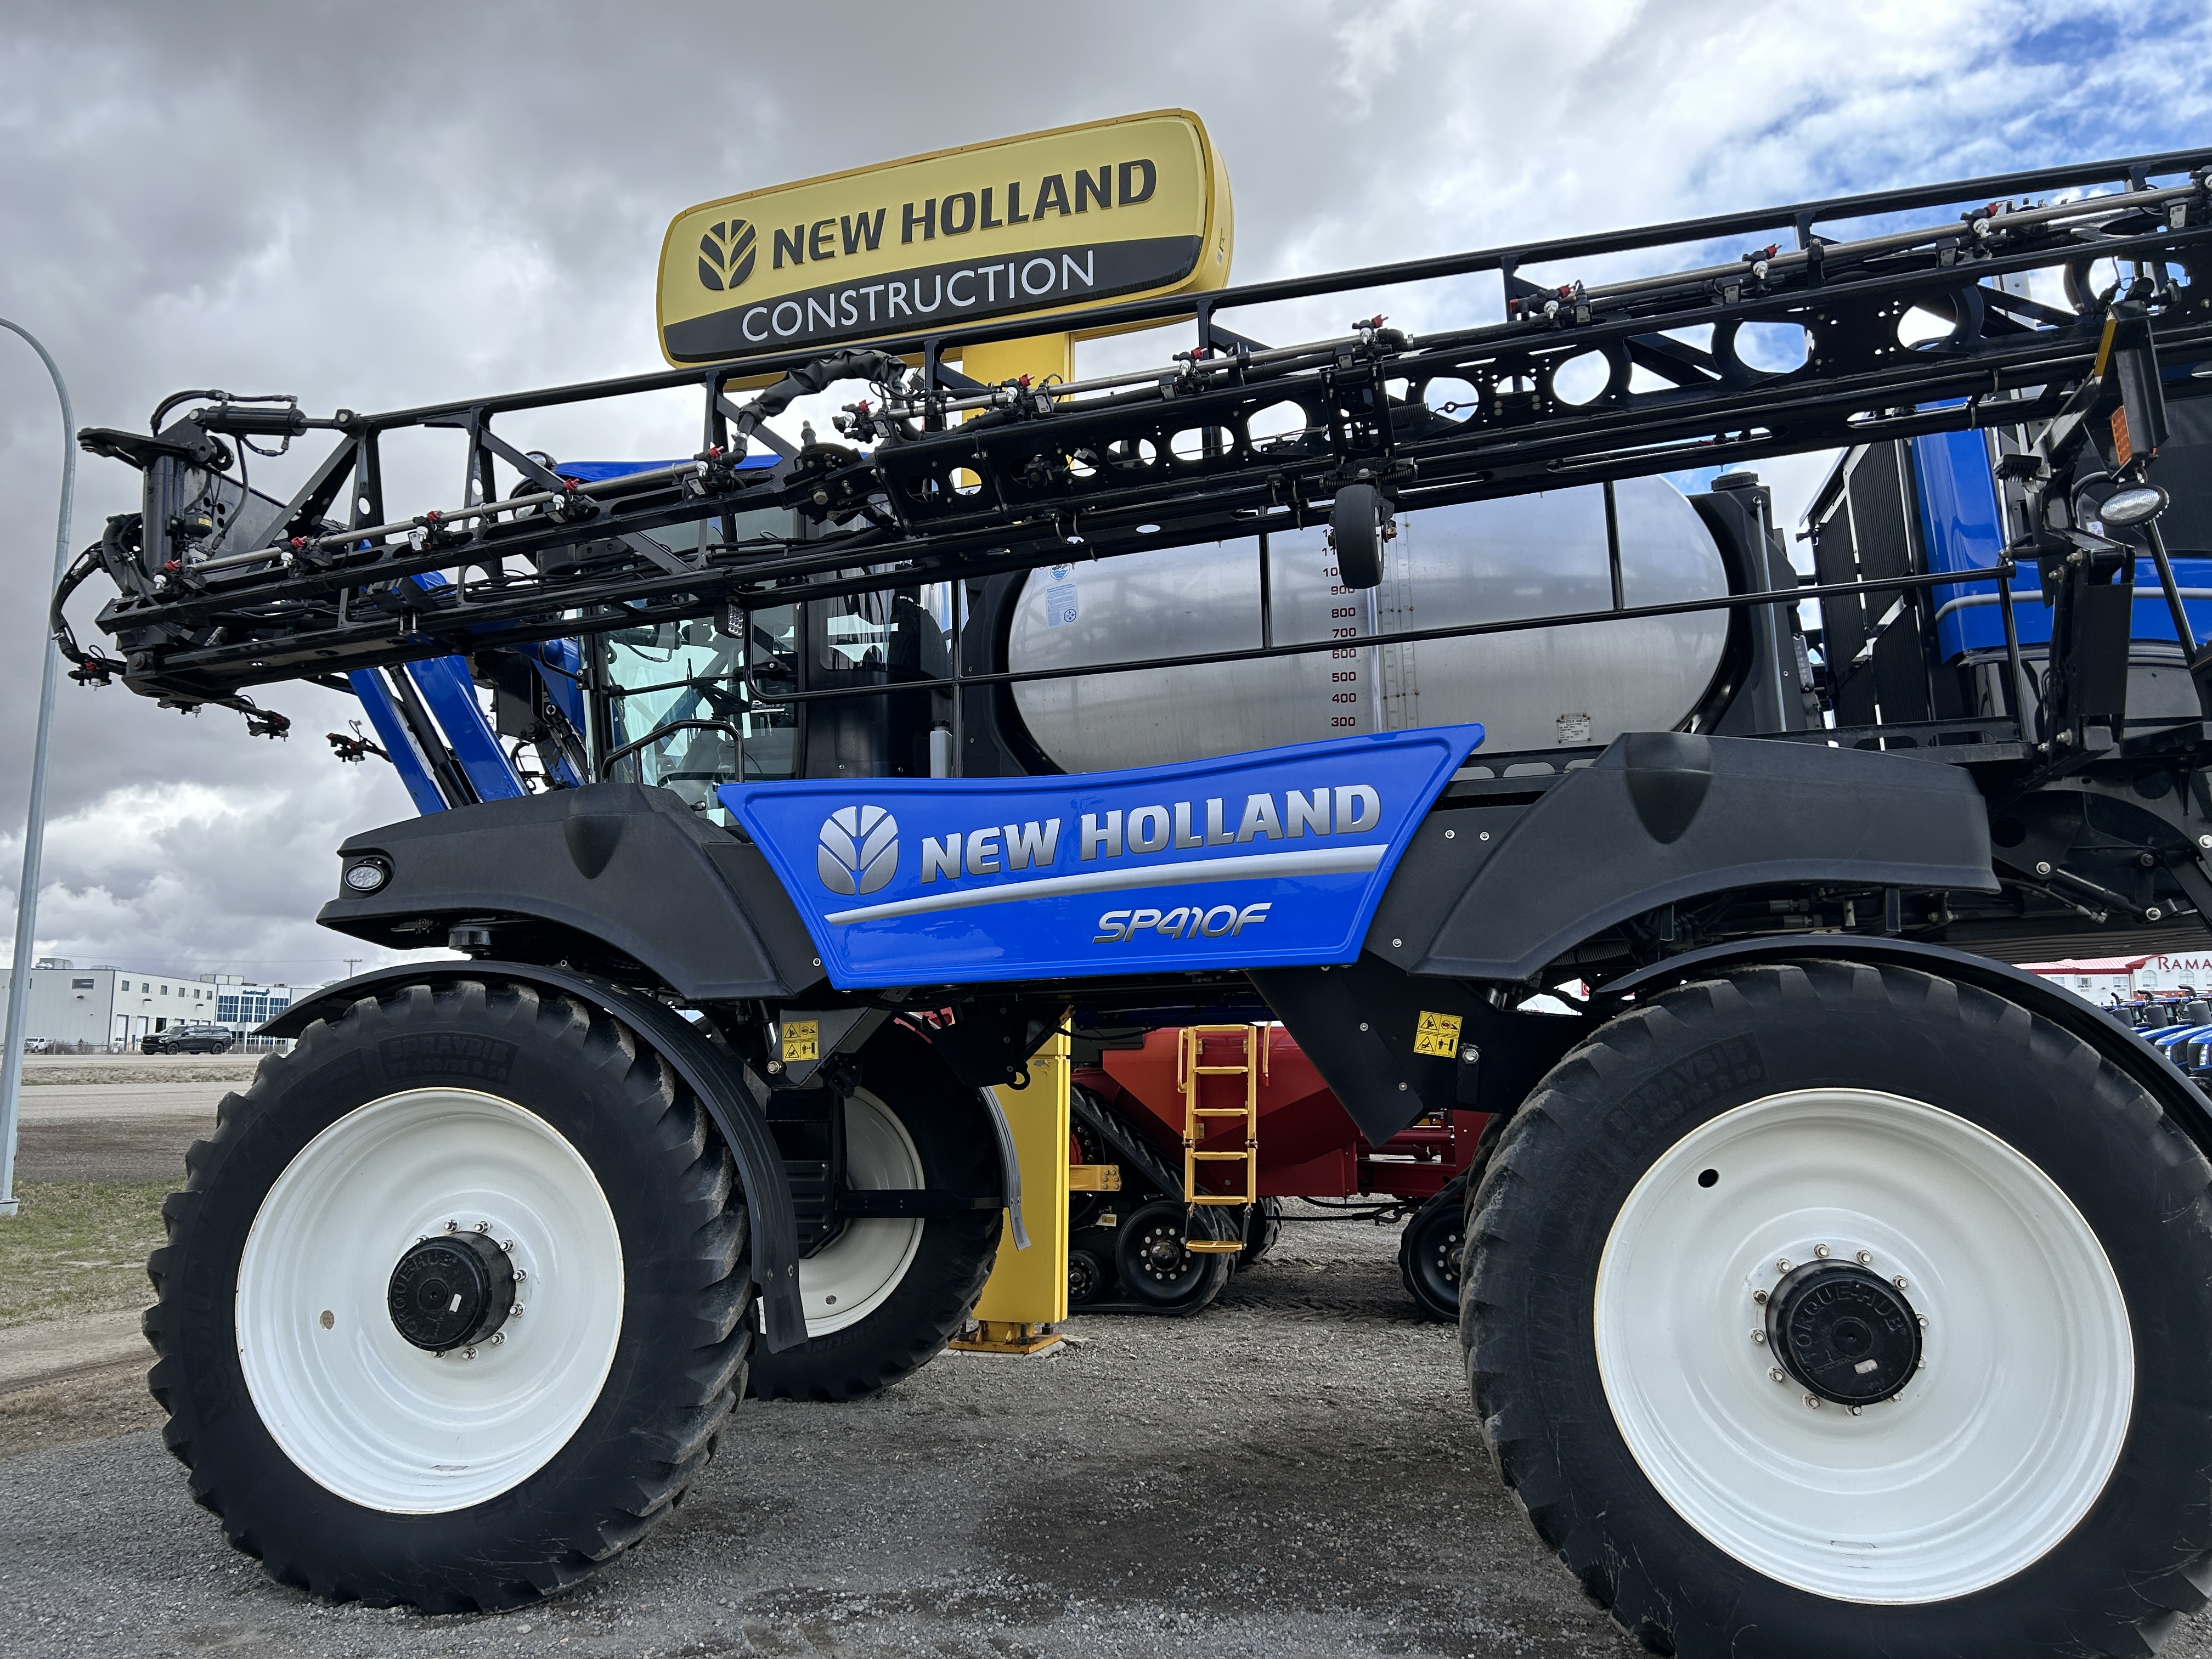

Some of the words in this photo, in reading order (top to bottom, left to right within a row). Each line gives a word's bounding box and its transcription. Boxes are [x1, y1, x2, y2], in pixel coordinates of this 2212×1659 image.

[772, 207, 887, 269] NEW
[901, 158, 1158, 245] HOLLAND
[742, 250, 1094, 342] CONSTRUCTION
[1331, 585, 1355, 595] 900
[1331, 607, 1356, 618] 800
[1332, 628, 1356, 639] 700
[1332, 648, 1356, 659] 600
[1332, 672, 1356, 682] 500
[1332, 693, 1356, 703] 400
[1331, 716, 1356, 727] 300
[921, 816, 1062, 884] NEW
[1080, 784, 1382, 861] HOLLAND
[1092, 902, 1272, 944] SP410F
[2158, 956, 2212, 969] RAMA
[388, 1036, 508, 1063] SPRAYBIB
